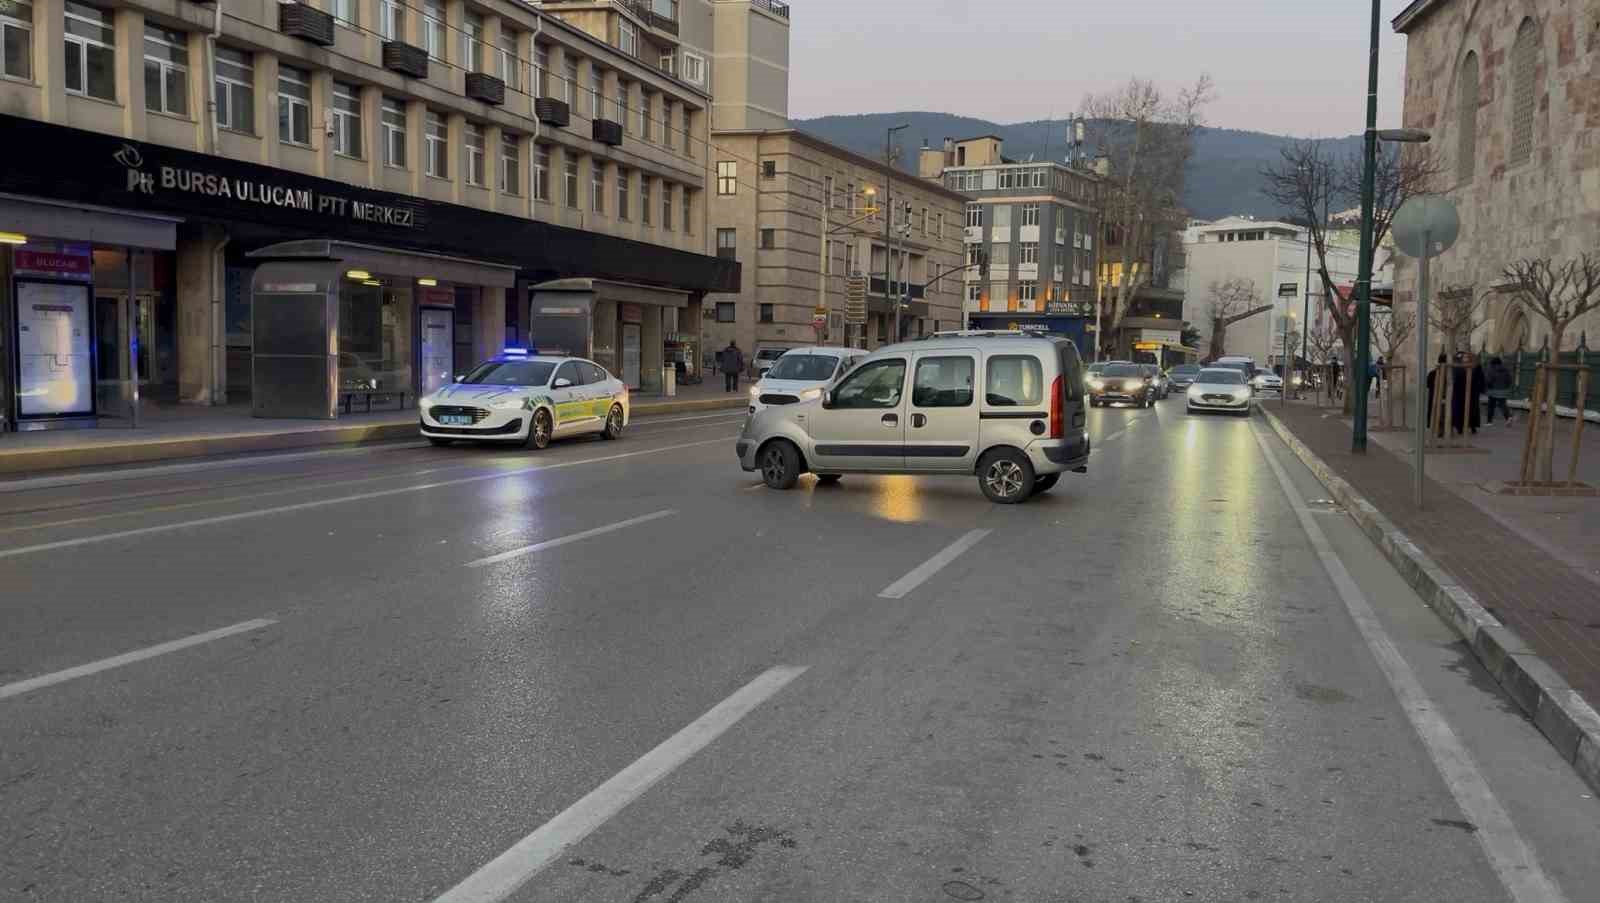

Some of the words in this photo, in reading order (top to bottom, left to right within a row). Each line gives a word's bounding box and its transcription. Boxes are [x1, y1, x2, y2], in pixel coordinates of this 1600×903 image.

[127, 168, 154, 194] Ptt
[161, 166, 232, 198] BURSA
[317, 195, 348, 216] PTT
